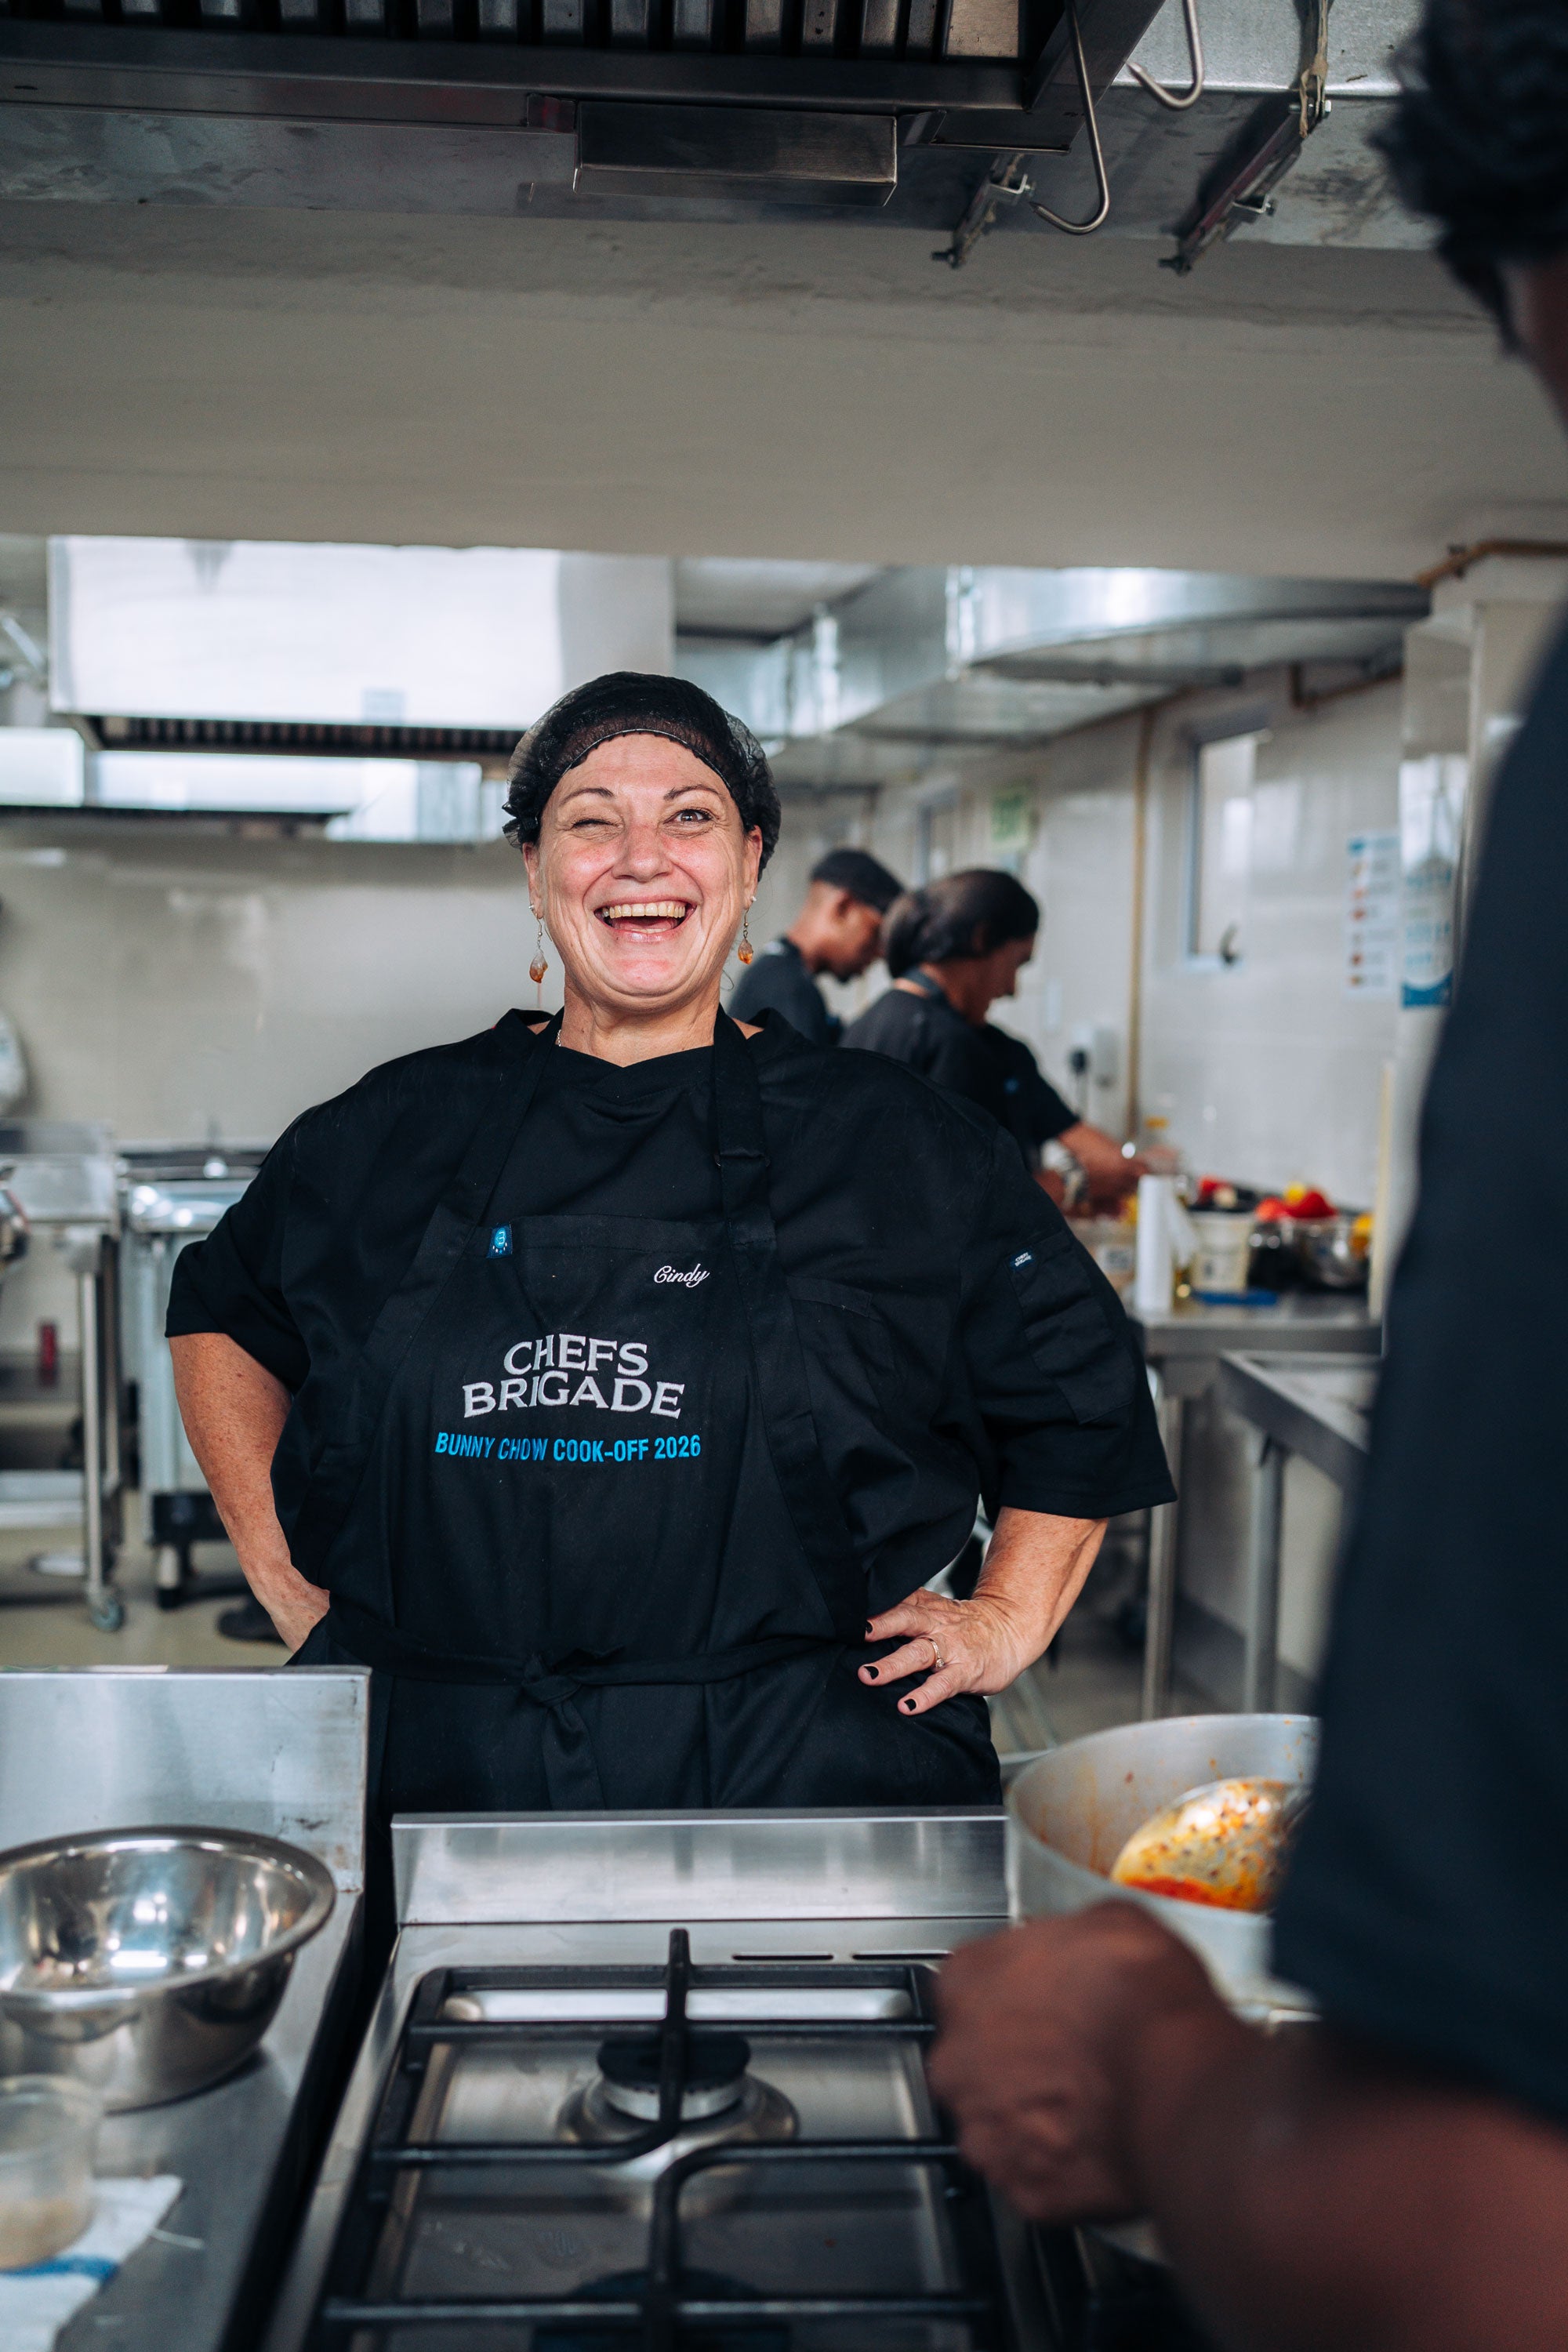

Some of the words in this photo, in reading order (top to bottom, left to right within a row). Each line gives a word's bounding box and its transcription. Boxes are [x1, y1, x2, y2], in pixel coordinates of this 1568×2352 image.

[653, 1262, 710, 1288] Cindy
[503, 1333, 649, 1377] CHEFS
[462, 1370, 685, 1420] BRIGADE
[434, 1431, 496, 1459] BUNNY
[496, 1437, 549, 1461] CHOW
[553, 1437, 649, 1463] COOK-OFF
[654, 1434, 702, 1460] 2026
